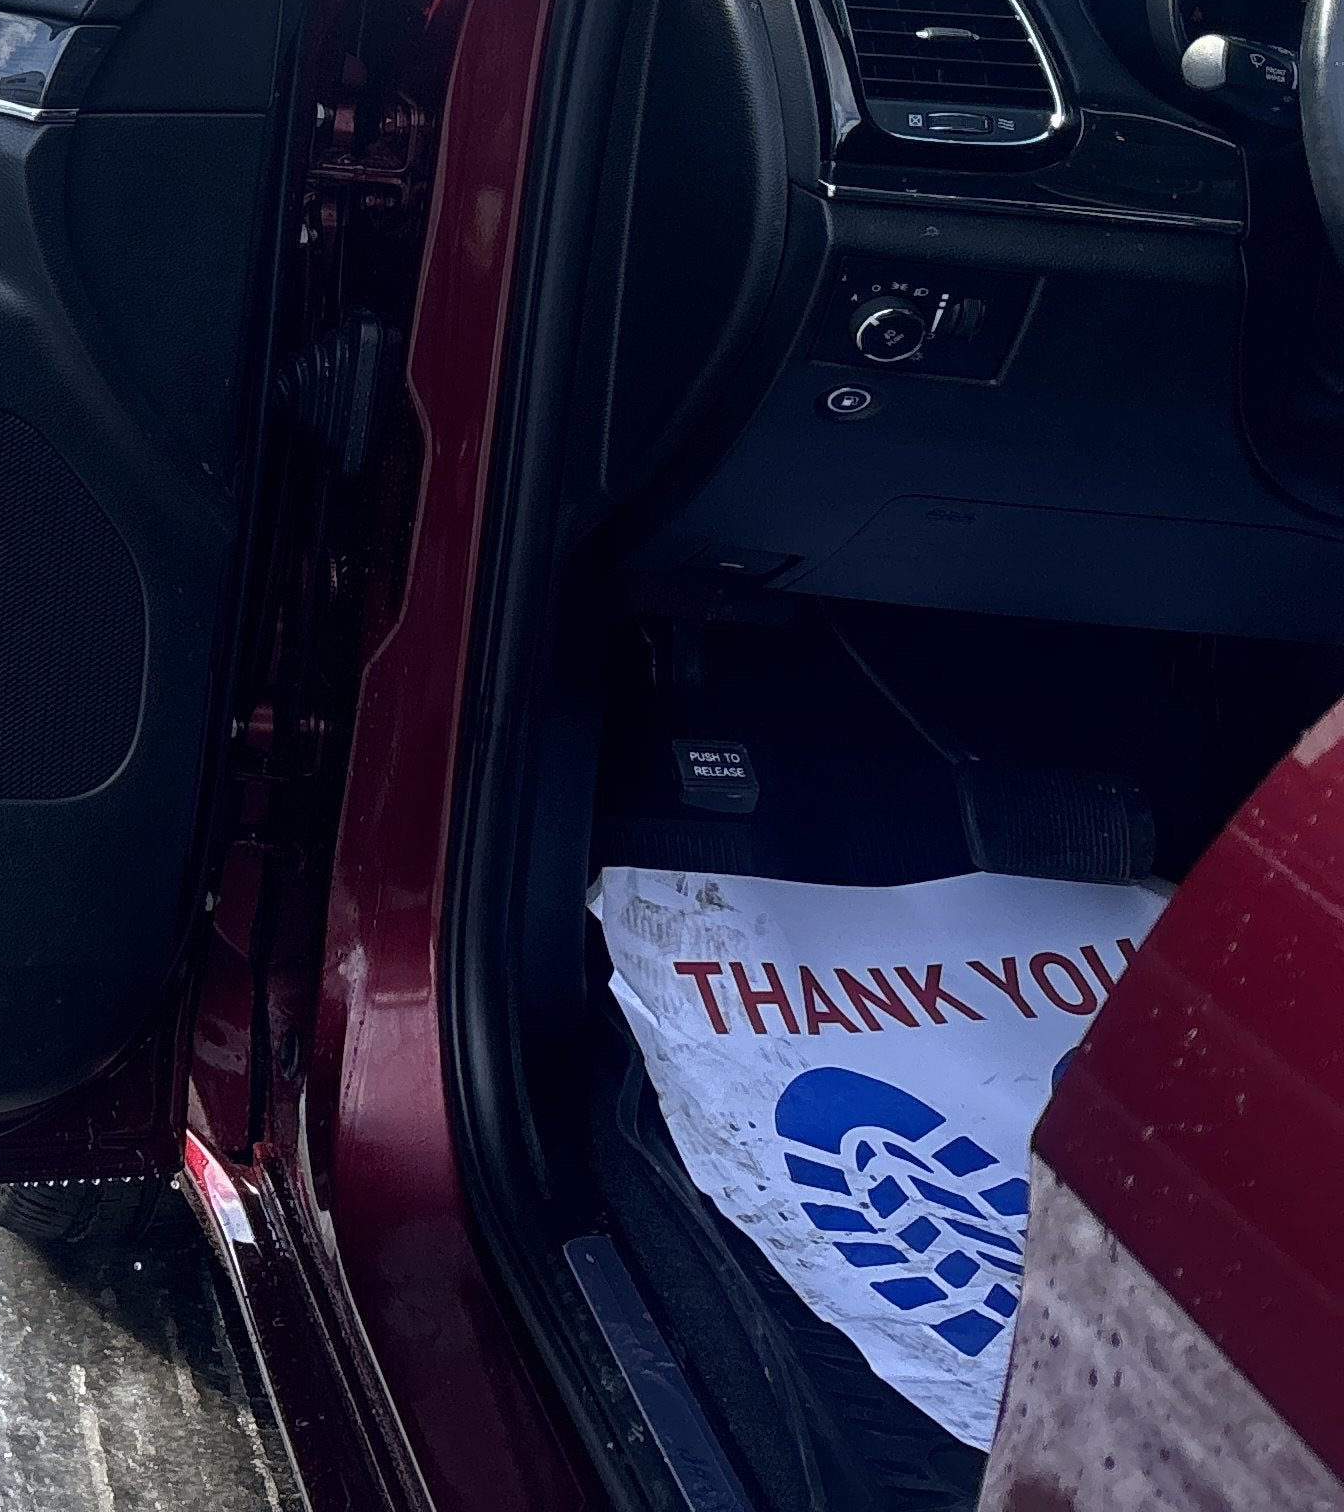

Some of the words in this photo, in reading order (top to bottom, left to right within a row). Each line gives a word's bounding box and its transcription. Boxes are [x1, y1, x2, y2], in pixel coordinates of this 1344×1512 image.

[689, 751, 721, 763] PUSH
[723, 752, 741, 763] TO
[693, 765, 746, 778] RELEASE
[673, 961, 988, 1036] THANK
